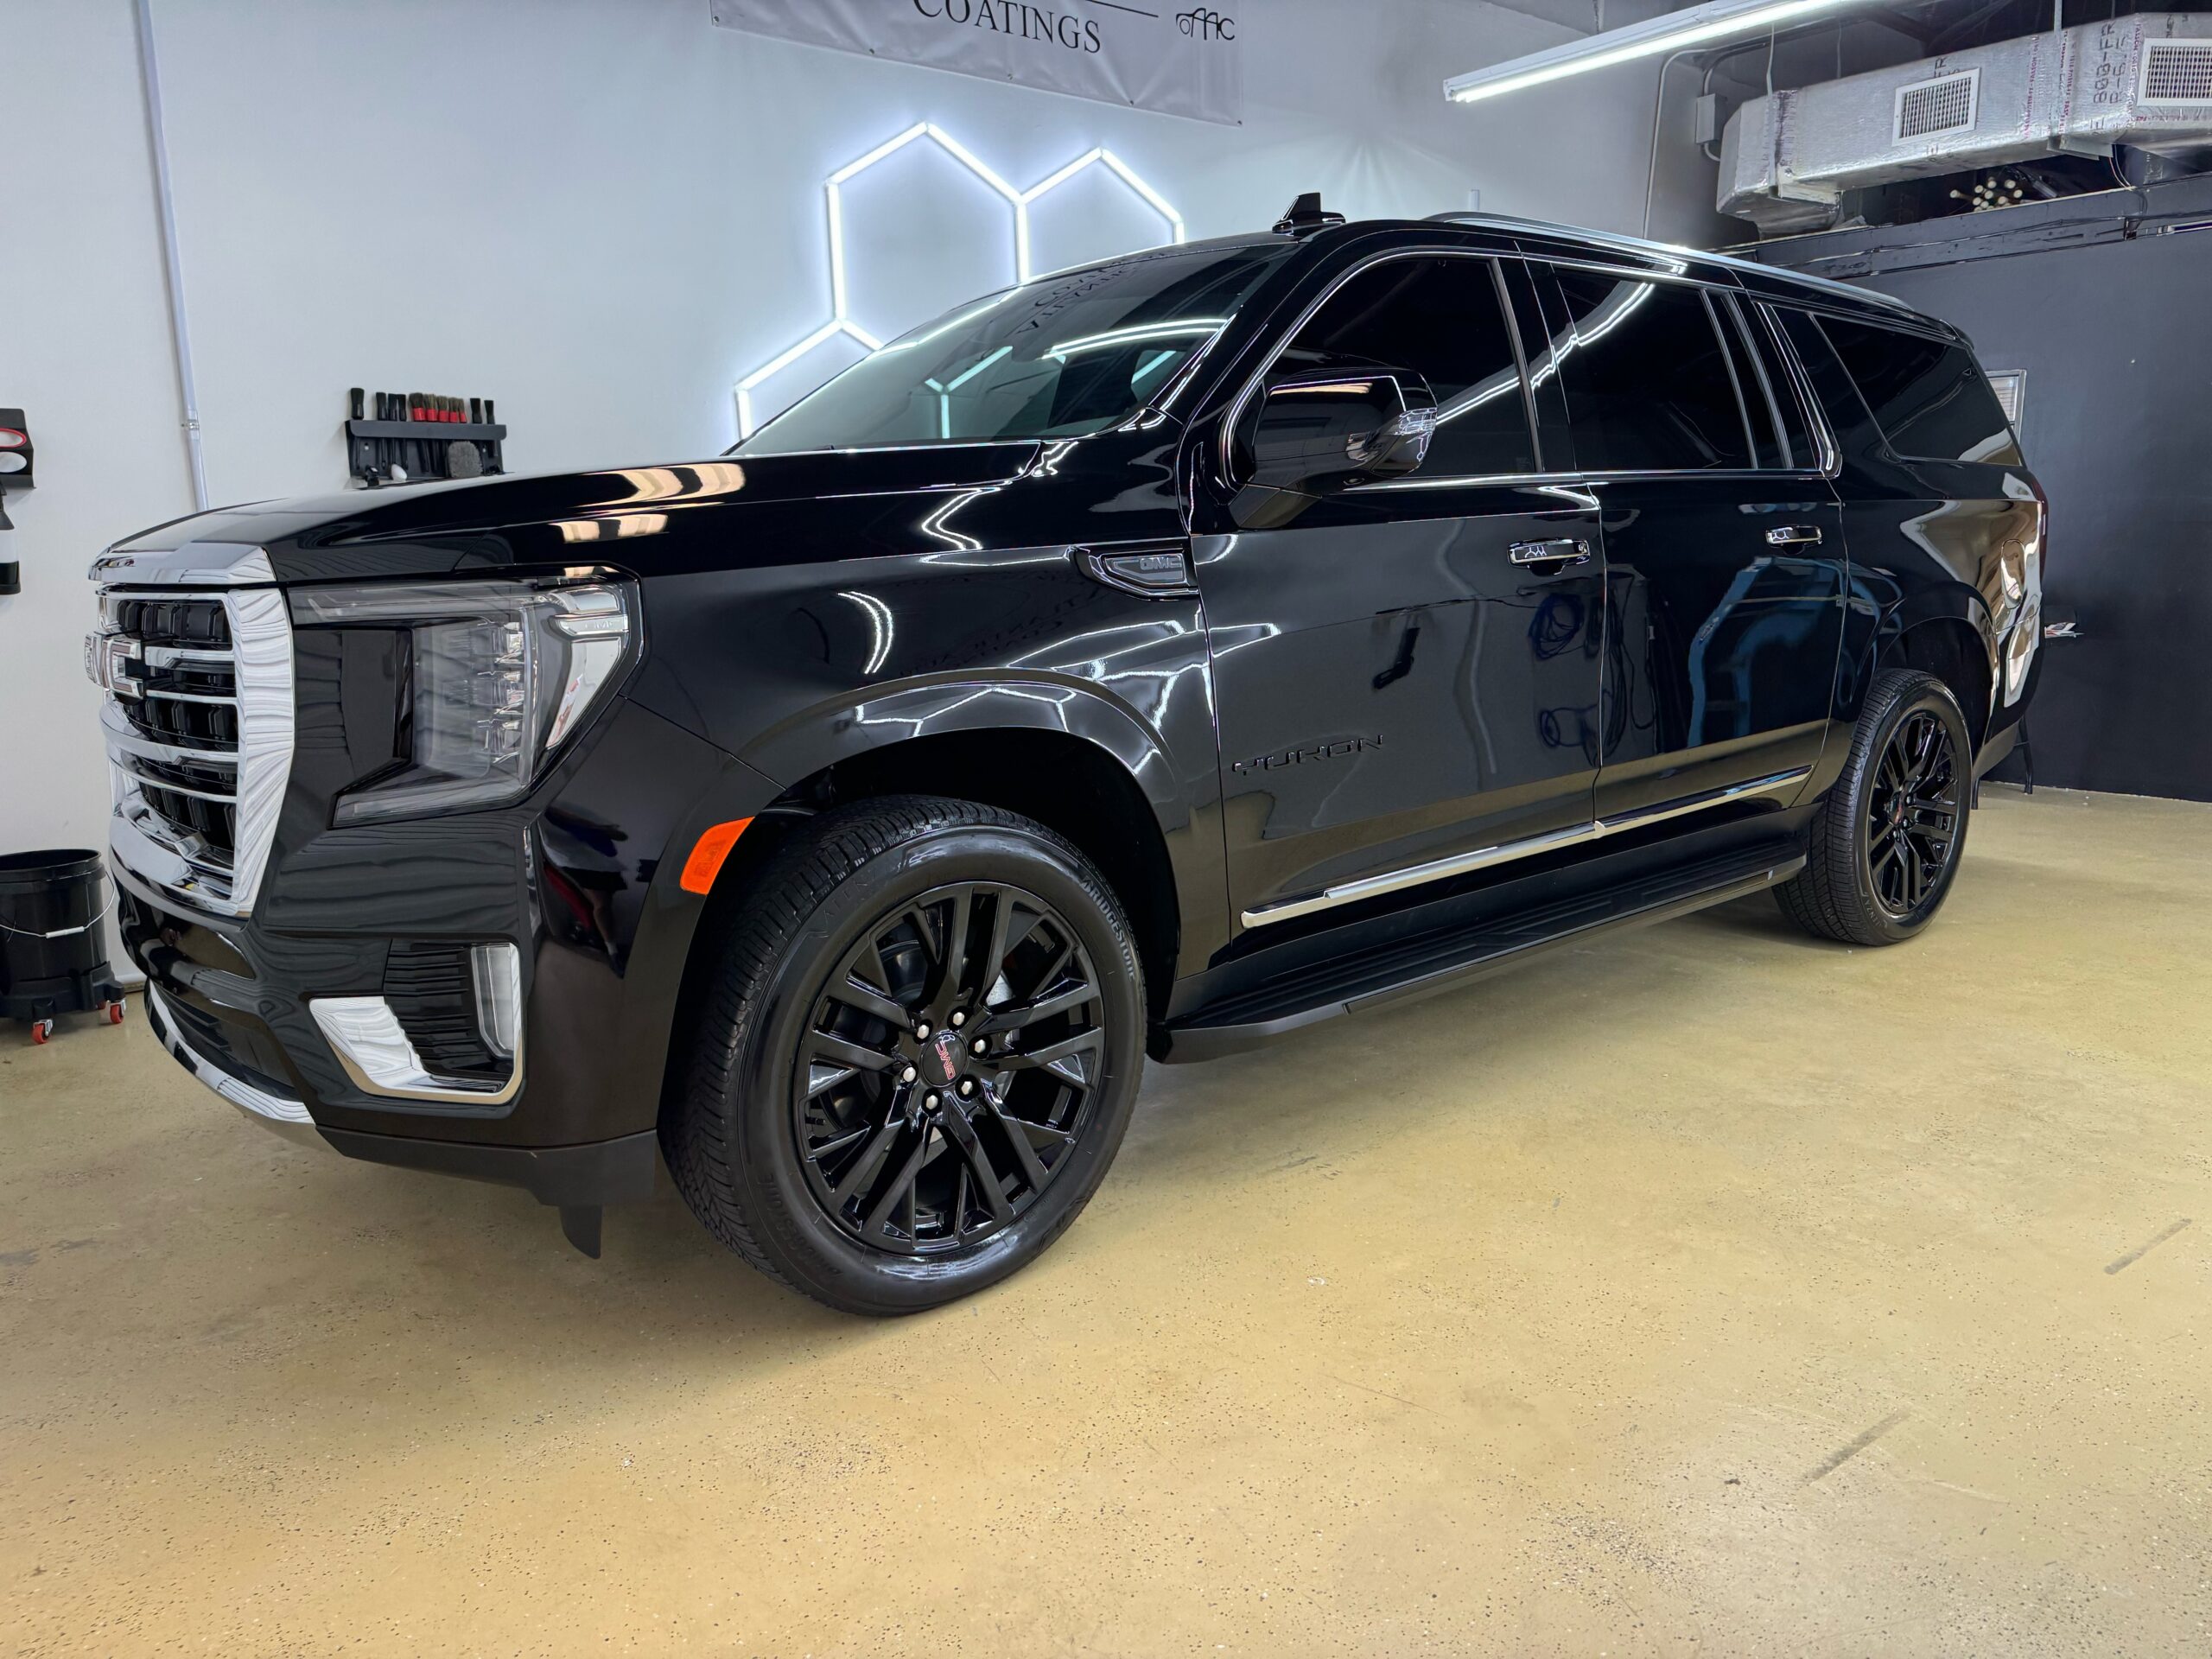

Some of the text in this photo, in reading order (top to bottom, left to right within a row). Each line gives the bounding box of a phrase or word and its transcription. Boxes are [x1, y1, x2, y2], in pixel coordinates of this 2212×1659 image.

[1140, 557, 1183, 570] GMC
[1231, 734, 1383, 776] YUKON
[1079, 876, 1136, 982] BRIDGESTONE
[934, 1040, 957, 1080] GMC
